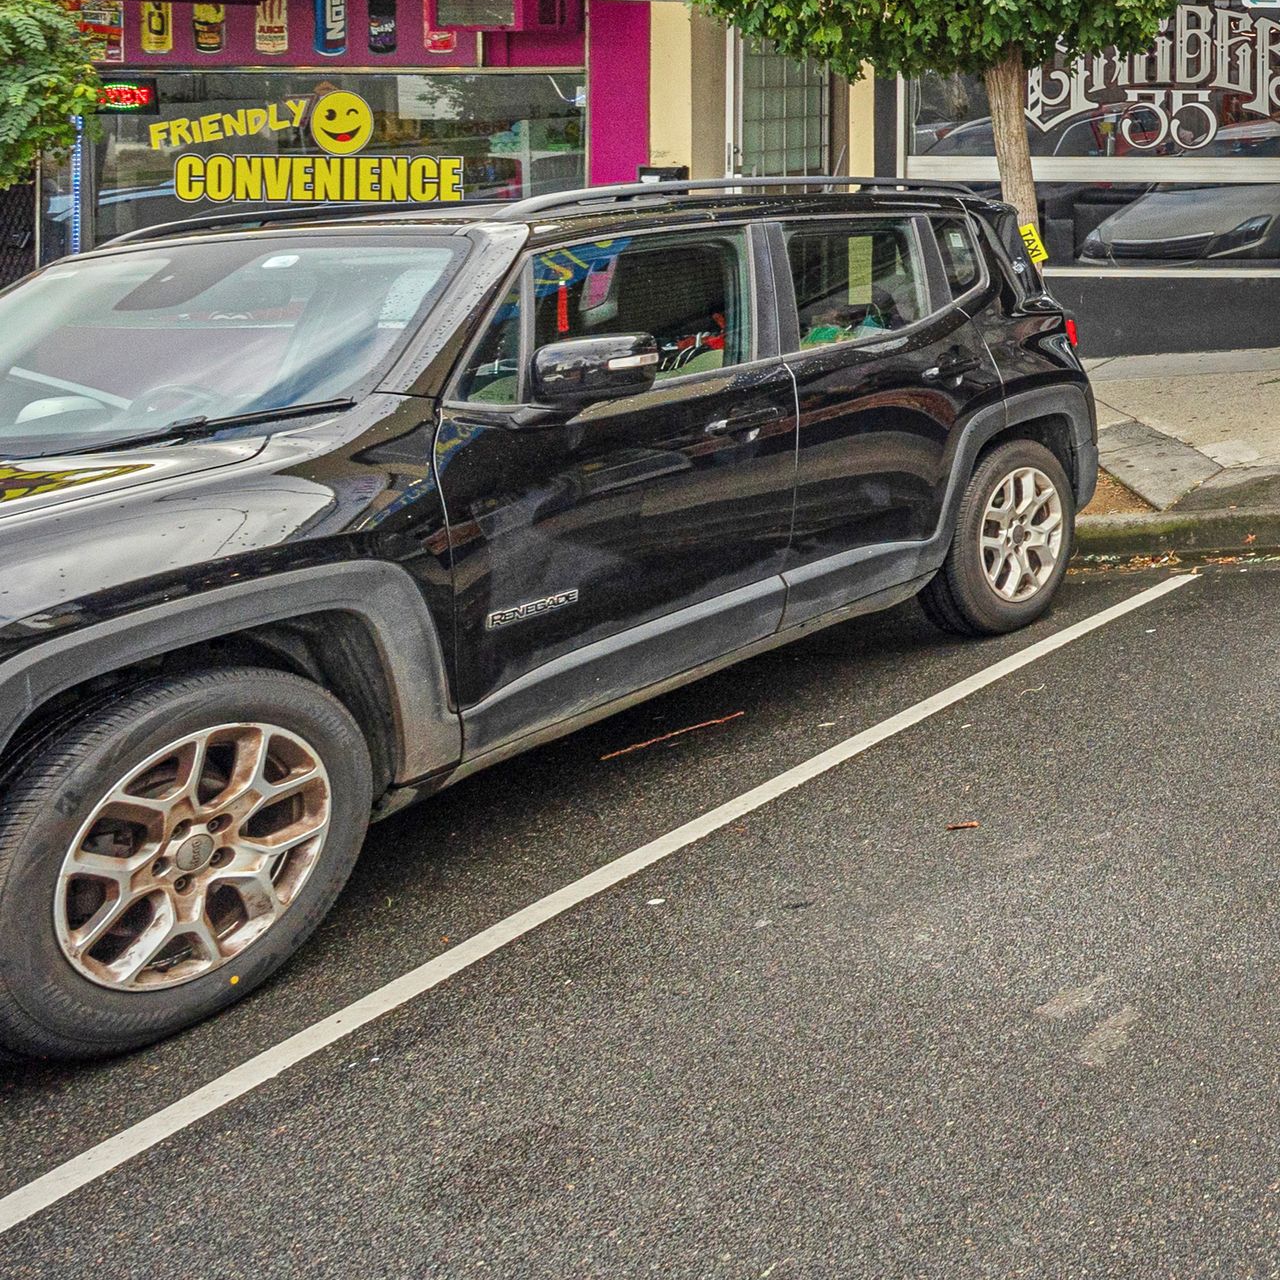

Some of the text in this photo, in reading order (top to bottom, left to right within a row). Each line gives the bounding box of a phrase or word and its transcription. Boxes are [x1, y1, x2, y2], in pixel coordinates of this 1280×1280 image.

[150, 99, 306, 150] FRIENDLY
[1121, 89, 1217, 149] 35
[174, 154, 464, 203] CONVENIENCE
[1021, 229, 1042, 258] TAXI
[486, 589, 579, 630] RENEGADE
